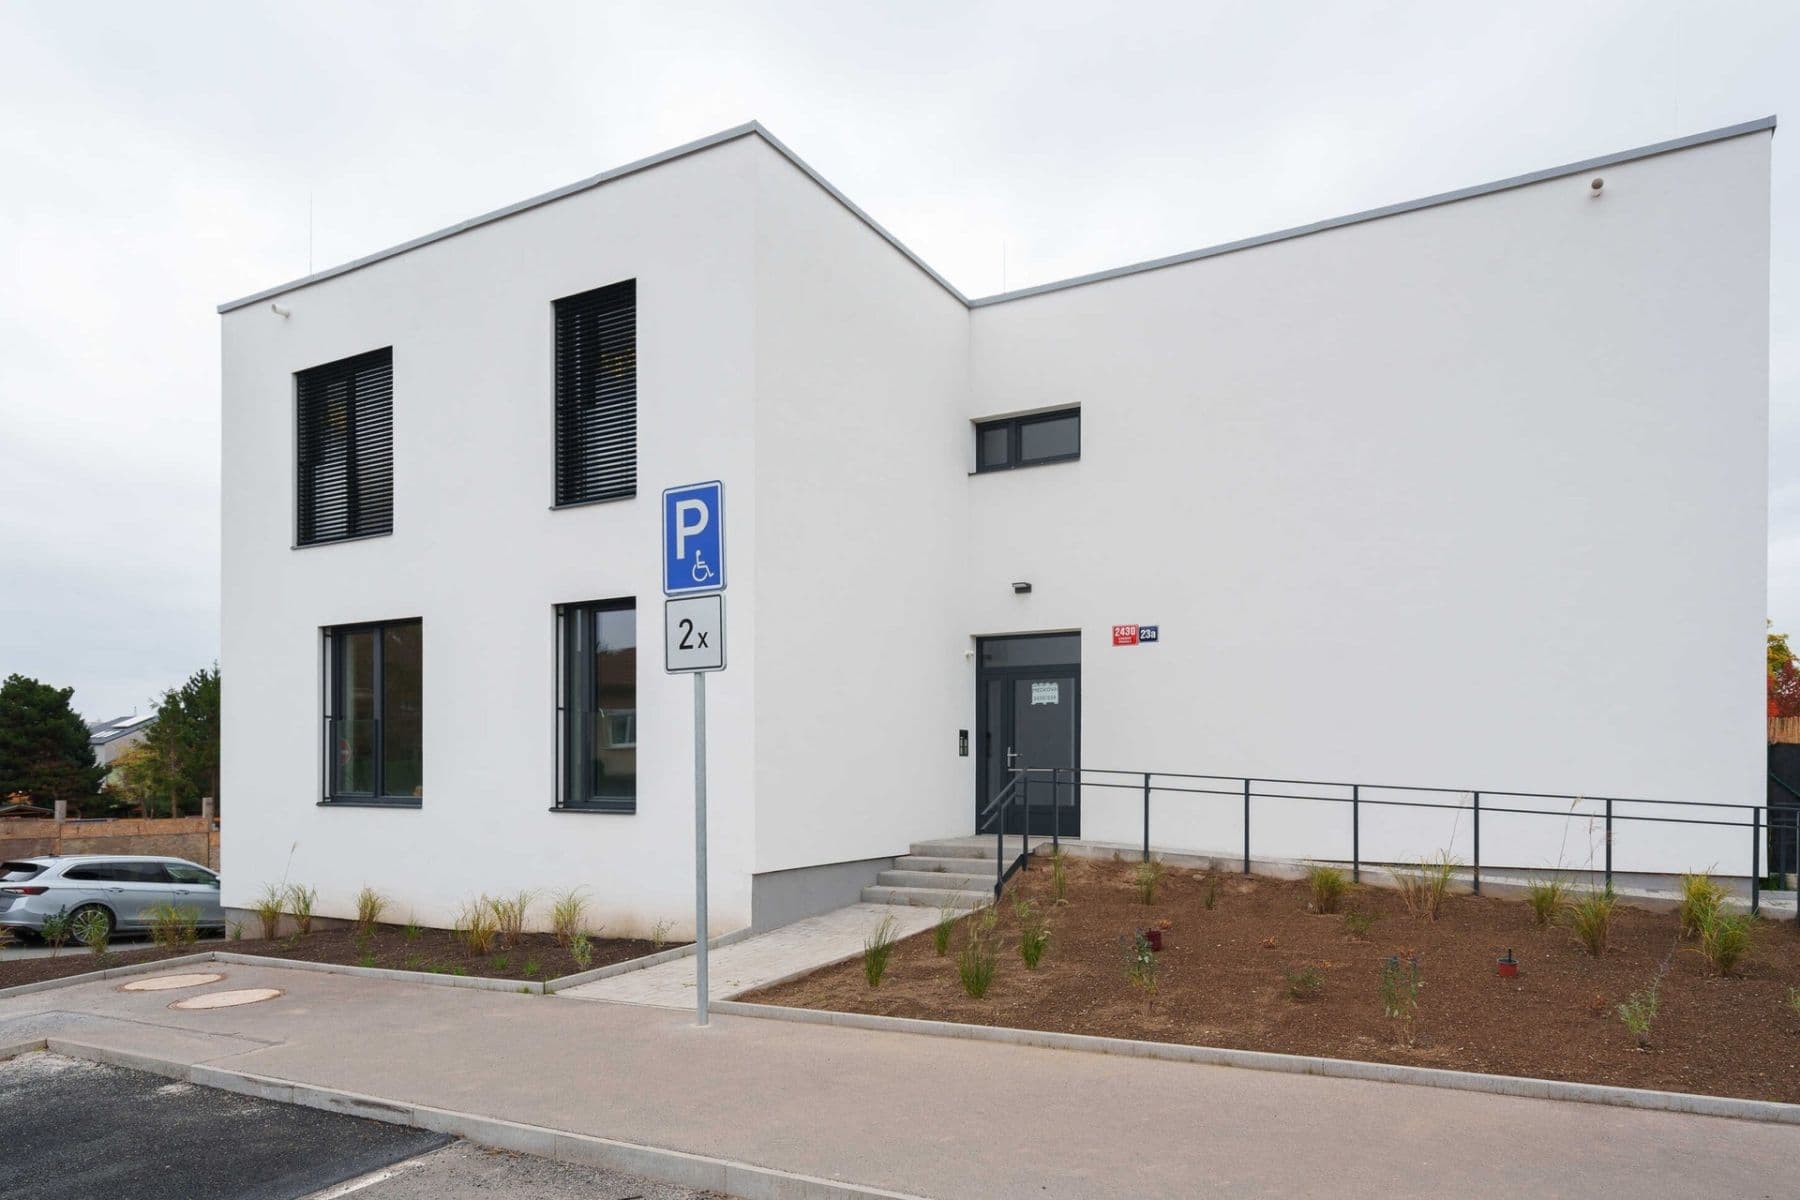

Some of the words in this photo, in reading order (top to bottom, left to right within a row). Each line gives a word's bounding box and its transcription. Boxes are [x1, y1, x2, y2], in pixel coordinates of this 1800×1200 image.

[676, 499, 709, 560] P
[679, 618, 709, 650] 2x
[1114, 626, 1136, 637] 2430
[1140, 629, 1156, 639] 23a
